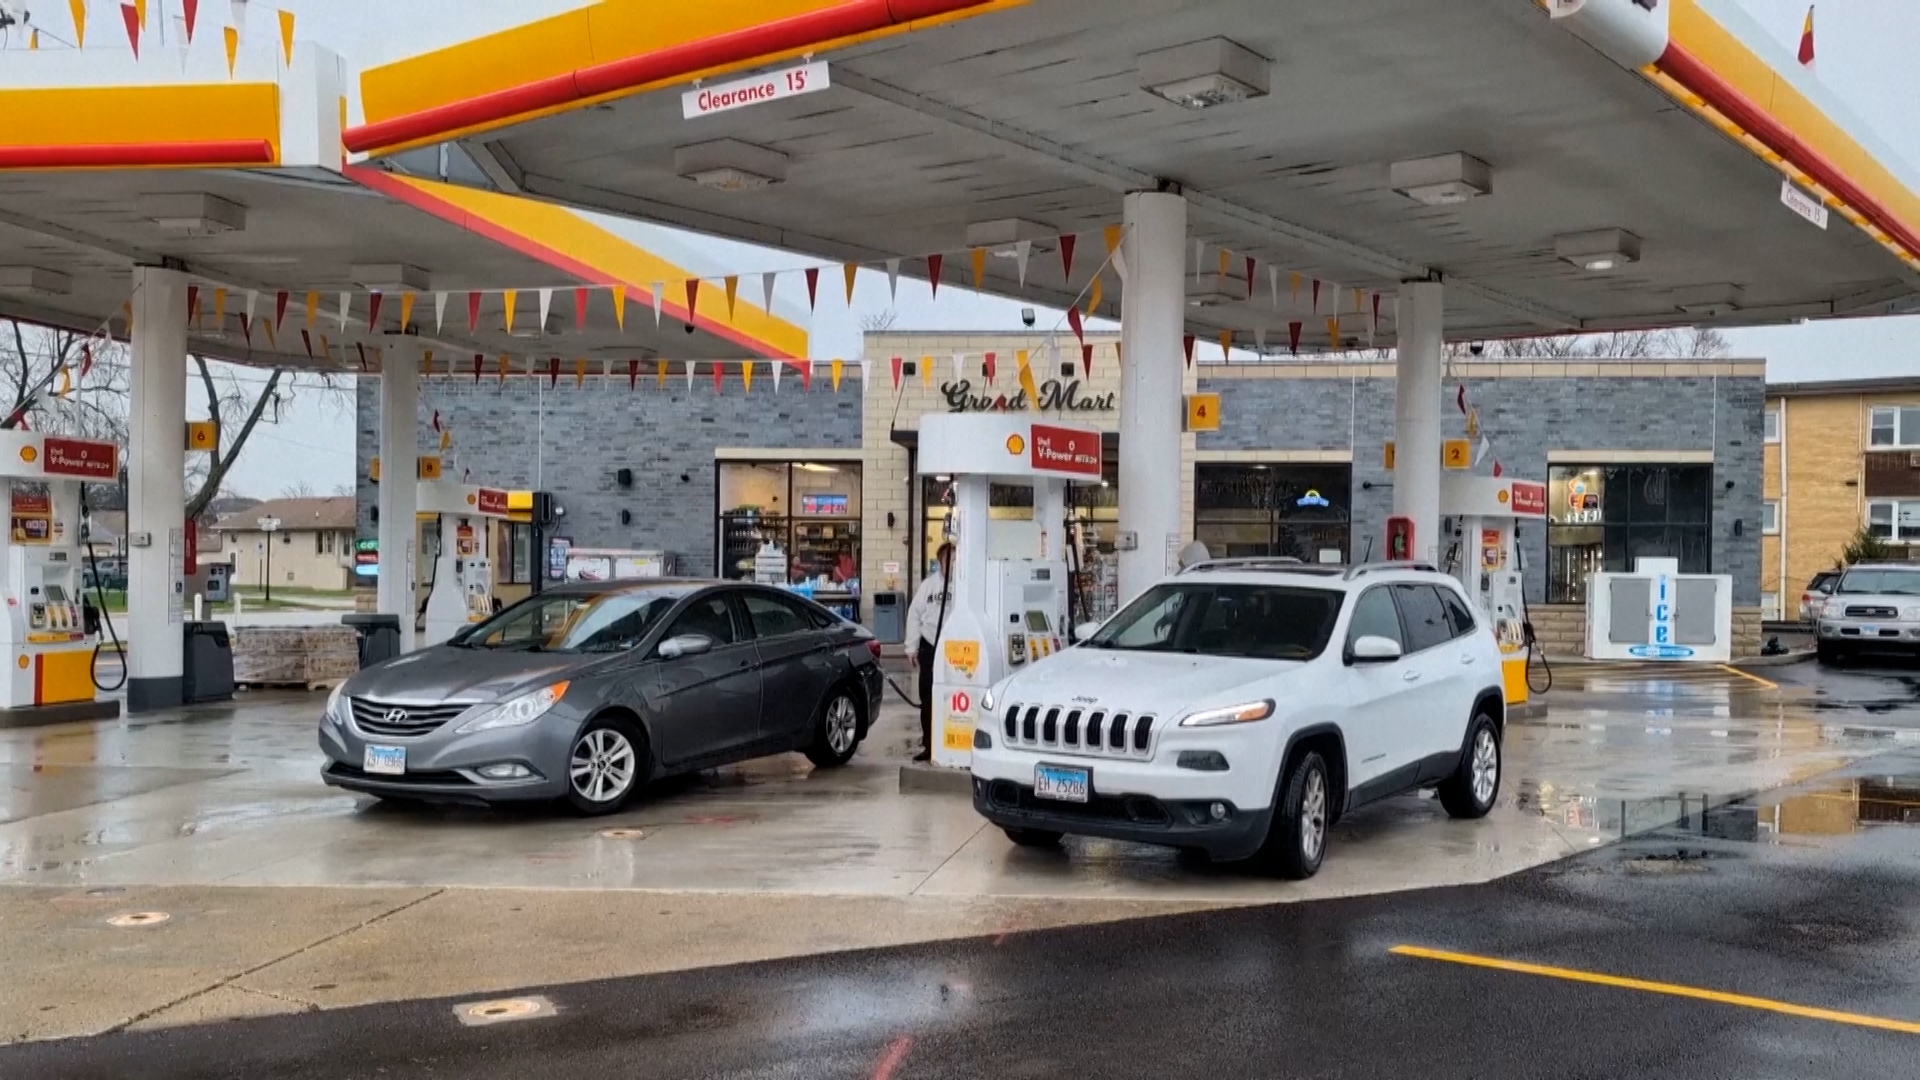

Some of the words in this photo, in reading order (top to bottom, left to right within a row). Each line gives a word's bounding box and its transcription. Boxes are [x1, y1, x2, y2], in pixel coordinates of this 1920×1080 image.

[698, 82, 776, 111] Clearance
[785, 70, 808, 91] 15'
[941, 379, 1027, 413] Grad
[1038, 379, 1115, 411] Mart
[1196, 404, 1207, 419] 4
[197, 430, 205, 442] 6
[1037, 446, 1073, 461] V-Power
[1451, 448, 1460, 460] 2
[951, 691, 970, 713] 10
